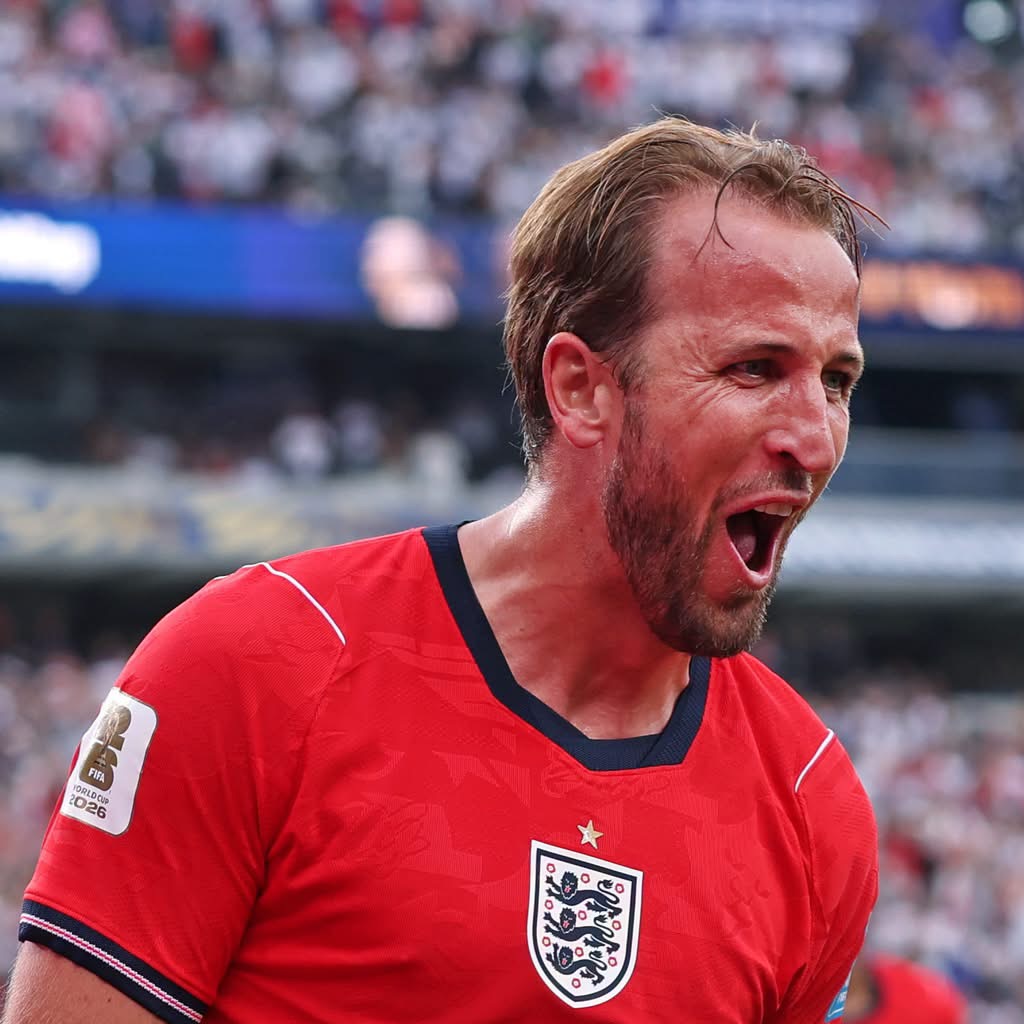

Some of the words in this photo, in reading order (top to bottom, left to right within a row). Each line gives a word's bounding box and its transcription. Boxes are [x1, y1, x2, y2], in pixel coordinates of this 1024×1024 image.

[88, 767, 105, 783] FIFA
[69, 793, 107, 819] 2026
[97, 795, 110, 805] CUP
